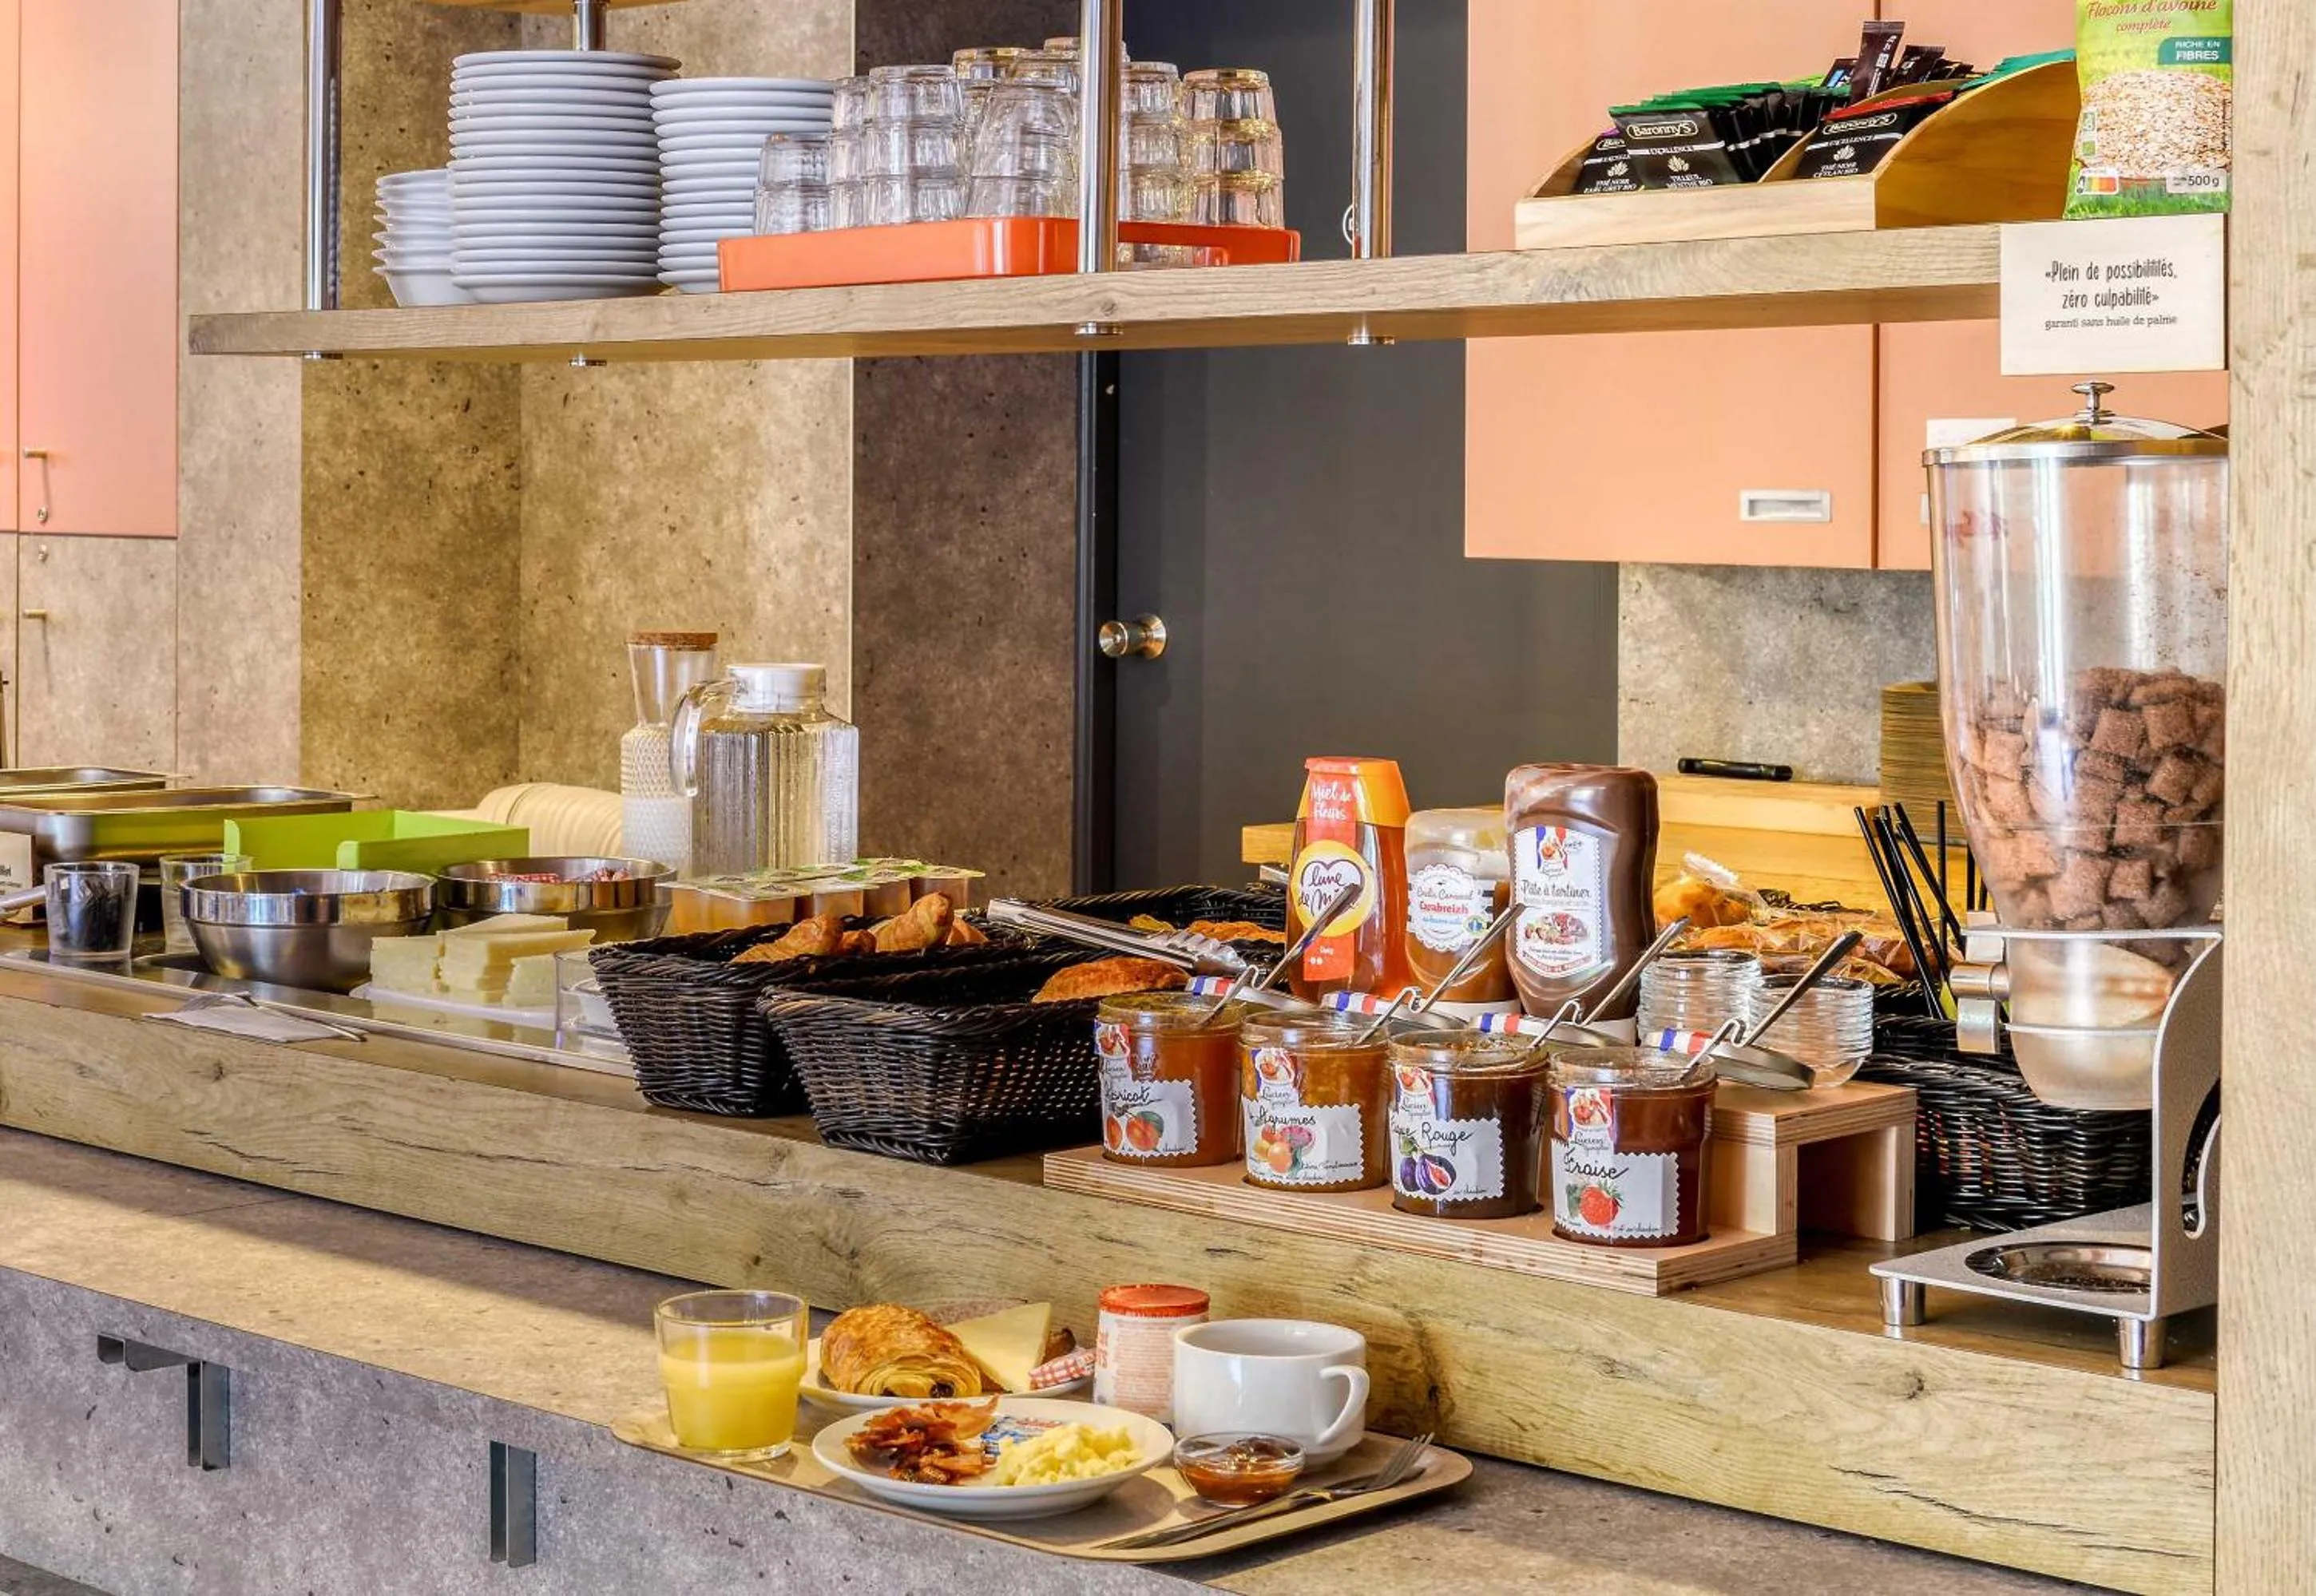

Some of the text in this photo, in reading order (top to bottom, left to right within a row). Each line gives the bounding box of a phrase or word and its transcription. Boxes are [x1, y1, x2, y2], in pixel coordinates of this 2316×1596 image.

[2087, 2, 2138, 20] Flocons
[2175, 50, 2219, 61] FIBRES
[2086, 261, 2100, 280] de
[2061, 289, 2088, 309] zéro
[2044, 314, 2178, 331] garanti sans huile de palme
[1311, 781, 1351, 803] Miel de
[1312, 802, 1348, 822] Fleurs
[1308, 866, 1346, 887] lune
[1521, 879, 1541, 895] Pâte
[1551, 883, 1592, 898] tartiner
[1421, 1121, 1477, 1157] Rouge
[1564, 1147, 1629, 1180] Fraise
